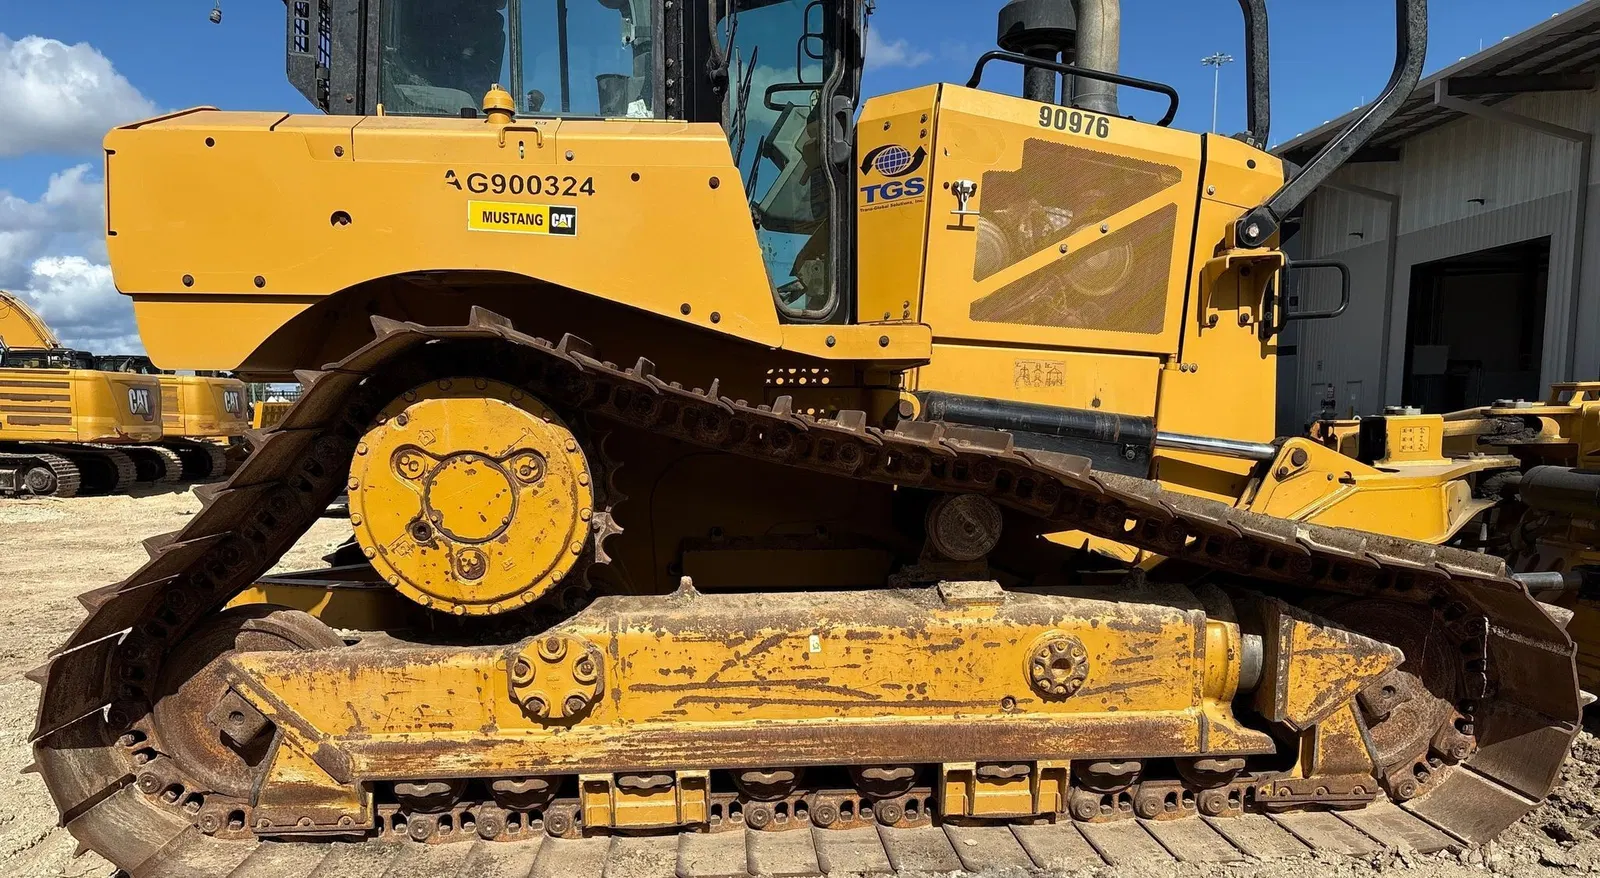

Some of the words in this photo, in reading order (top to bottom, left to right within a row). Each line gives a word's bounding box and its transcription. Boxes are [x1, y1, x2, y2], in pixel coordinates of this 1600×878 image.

[1039, 105, 1109, 138] 90976
[445, 169, 595, 196] AG900324
[860, 177, 925, 203] TGS
[482, 211, 543, 226] MUSTANG
[551, 213, 574, 228] CAT
[860, 204, 889, 212] Trans-Global
[128, 388, 149, 414] CAT
[224, 391, 239, 413] CAT
